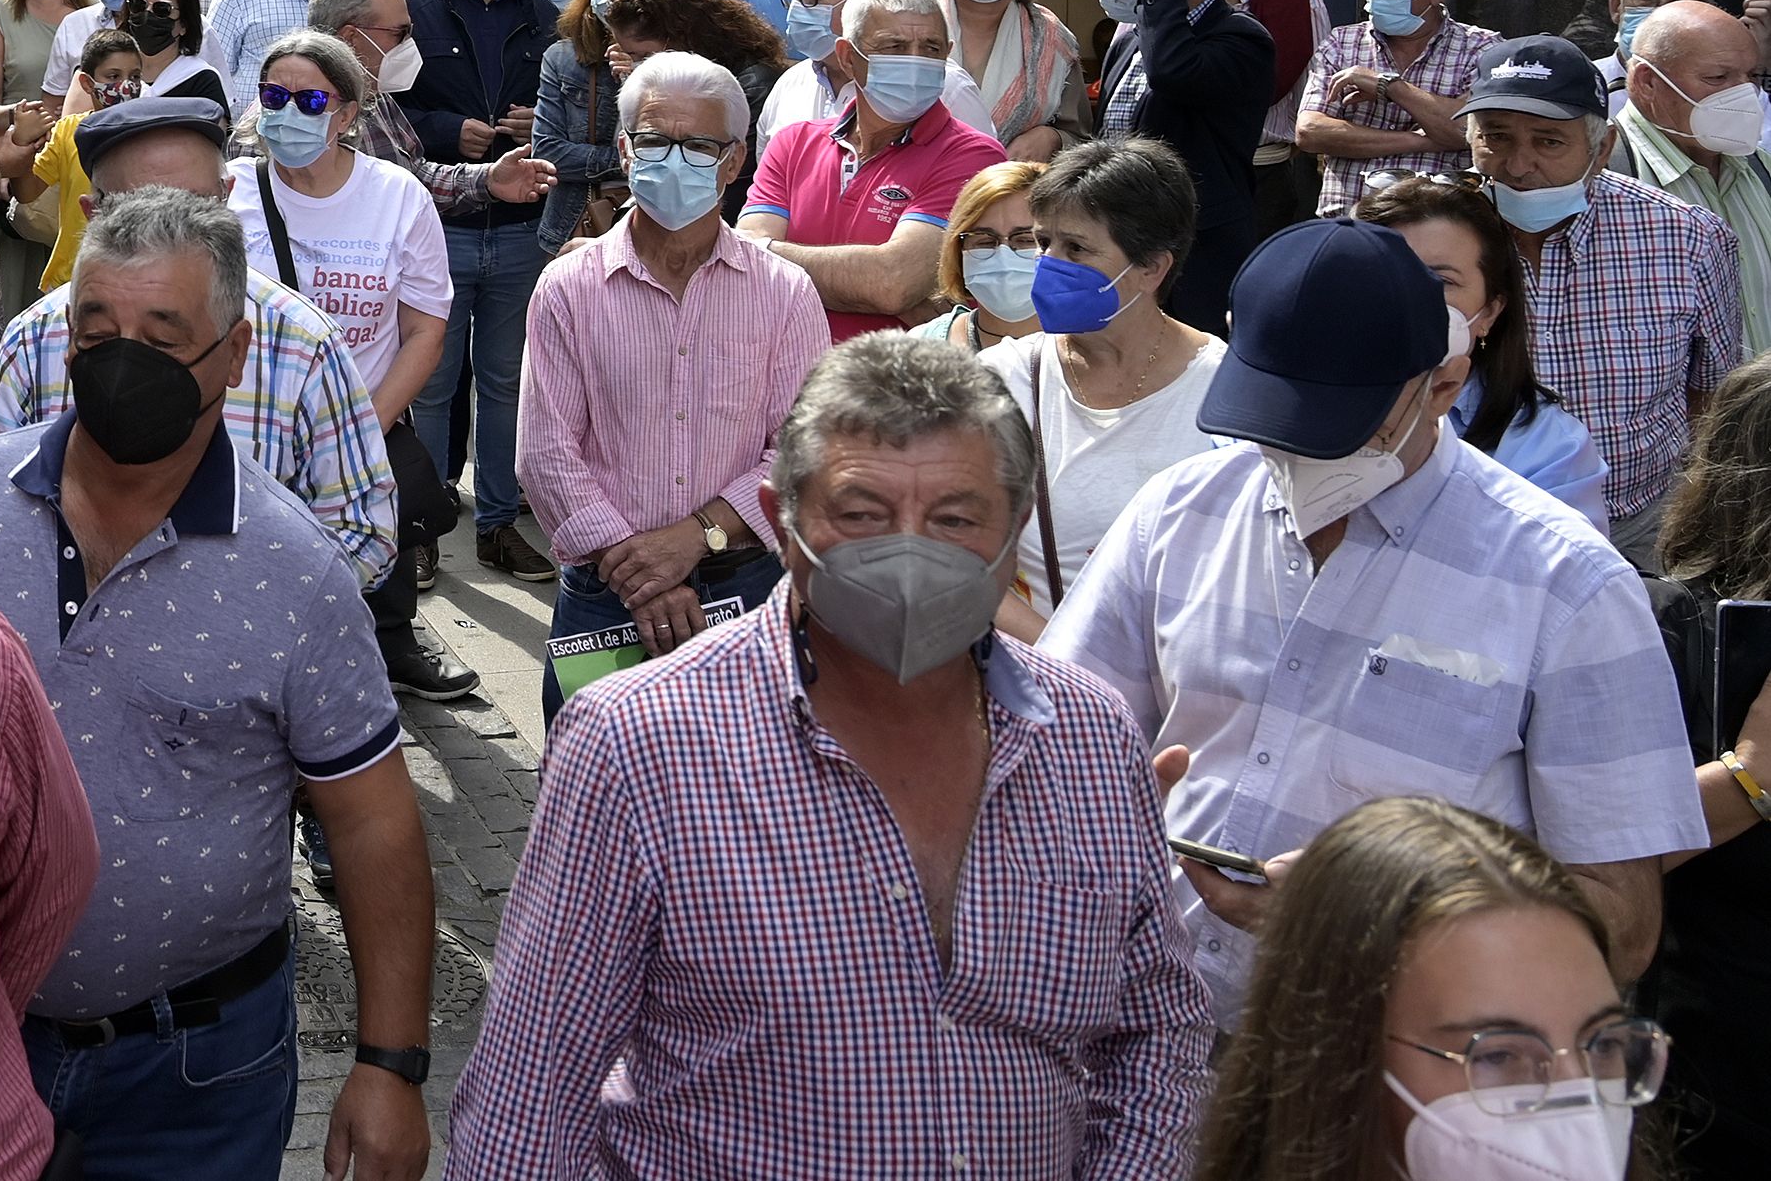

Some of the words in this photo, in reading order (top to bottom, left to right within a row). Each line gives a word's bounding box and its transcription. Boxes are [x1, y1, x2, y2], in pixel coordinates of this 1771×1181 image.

[313, 237, 380, 252] recortes
[312, 266, 389, 292] banca
[313, 292, 384, 318] ública
[550, 639, 595, 657] Escotet
[604, 633, 620, 647] de
[622, 630, 640, 645] Ab
